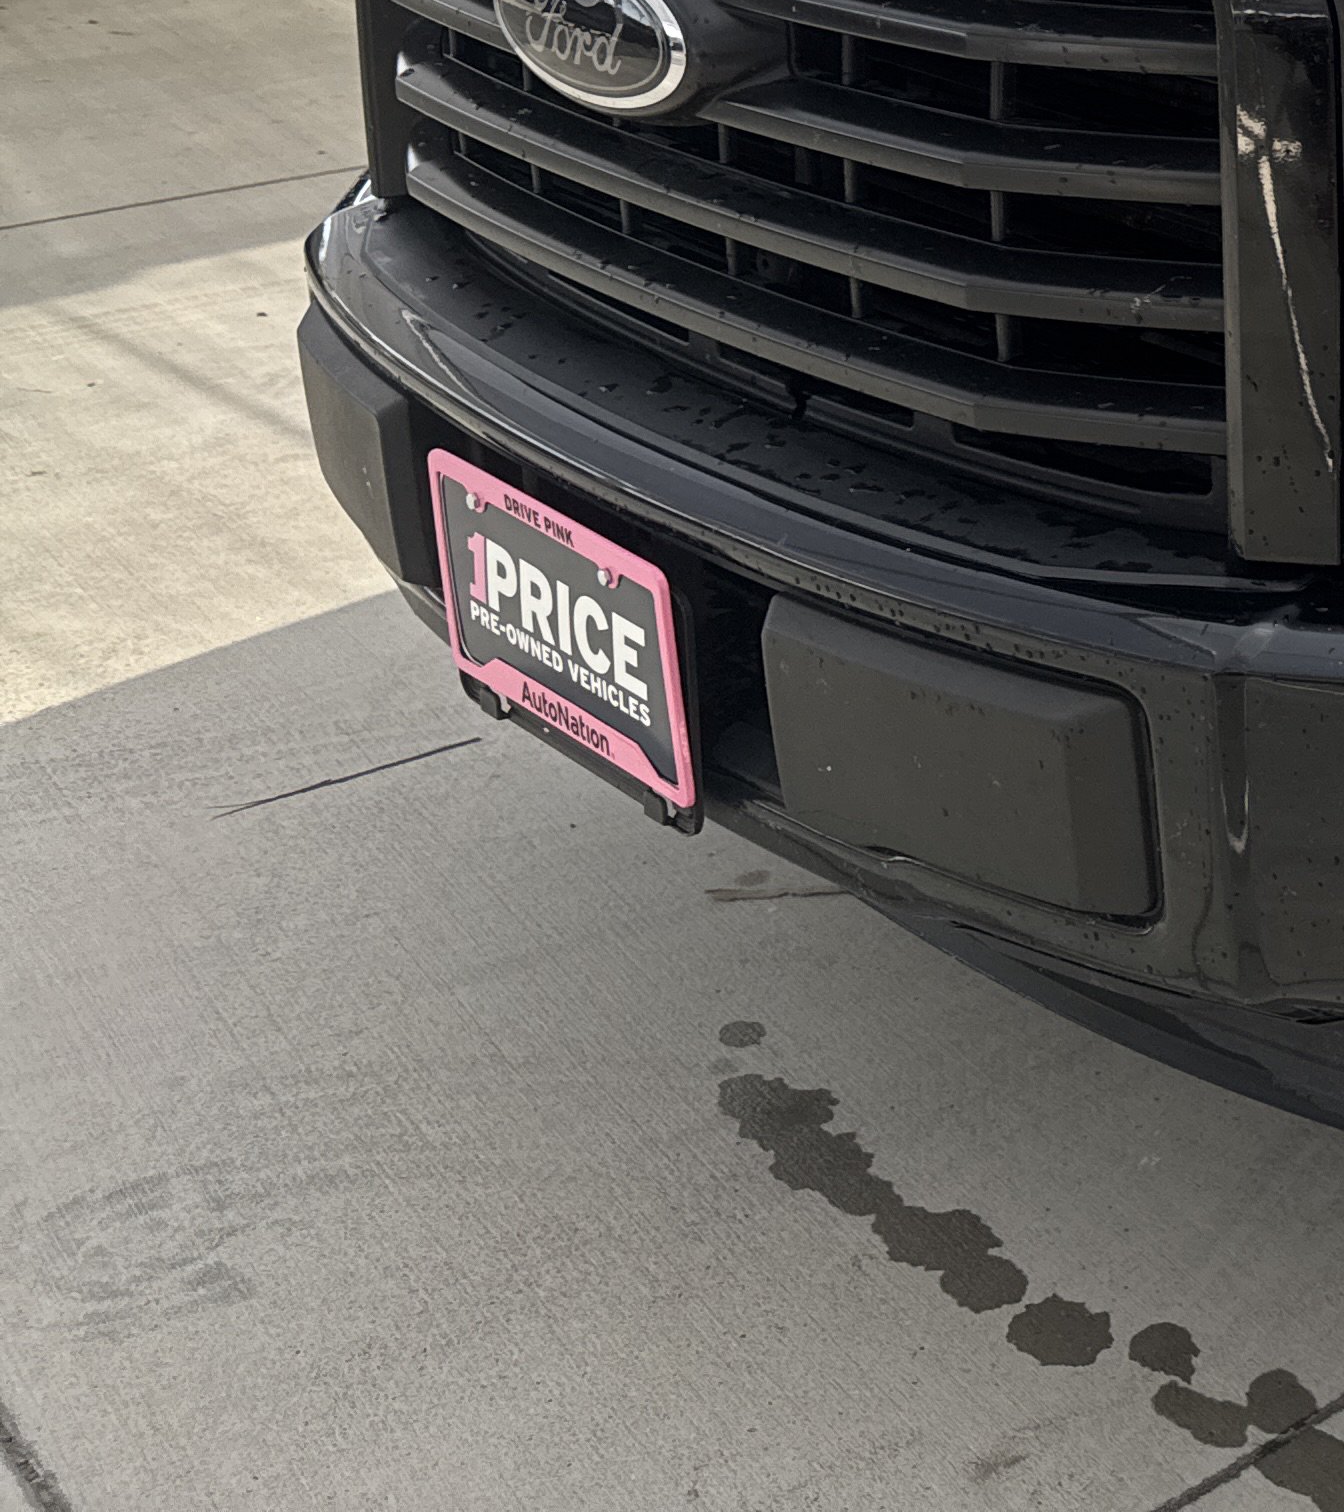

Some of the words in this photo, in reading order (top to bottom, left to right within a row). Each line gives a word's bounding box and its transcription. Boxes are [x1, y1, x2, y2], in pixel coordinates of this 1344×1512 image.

[503, 493, 541, 529] DRIVE
[543, 519, 574, 548] PINK
[470, 600, 564, 675] PRE-OWNED
[568, 659, 652, 727] VEHICLES
[521, 680, 612, 757] AutoNation
